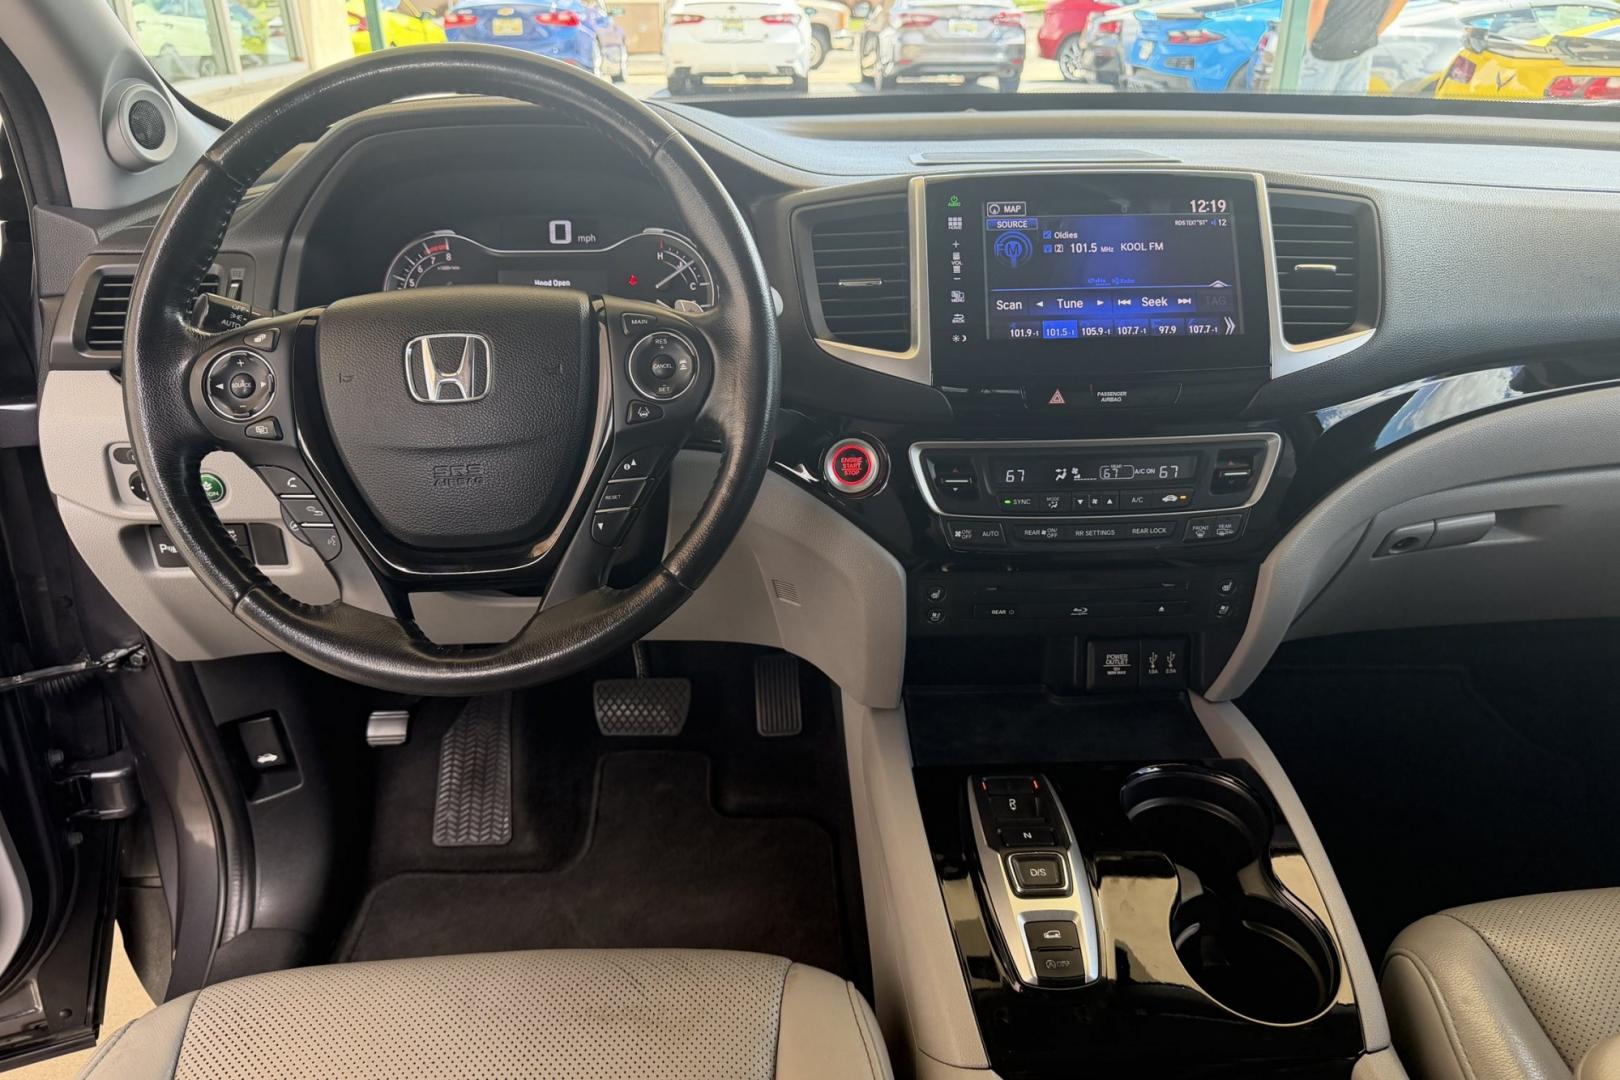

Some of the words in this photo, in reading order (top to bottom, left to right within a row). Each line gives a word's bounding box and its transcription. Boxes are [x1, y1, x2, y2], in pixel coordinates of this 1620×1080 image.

[1003, 204, 1022, 213] MAP
[1189, 199, 1227, 213] 12:19
[996, 220, 1029, 229] SOURCE
[1218, 218, 1227, 227] 12
[549, 220, 572, 244] 0
[1053, 231, 1079, 239] Oldies
[577, 235, 597, 243] mph
[1070, 242, 1098, 253] 101.5
[1120, 242, 1148, 251] KOOL
[1149, 241, 1164, 251] FM
[656, 252, 664, 261] H
[552, 279, 571, 287] Open
[689, 282, 697, 291] C
[996, 300, 1023, 311] Scan
[1056, 298, 1084, 309] Tune
[1141, 296, 1168, 307] Seek
[221, 318, 241, 328] AUTO
[1158, 325, 1177, 334] 97.9
[1005, 469, 1025, 483] 67
[1103, 468, 1119, 479] 67
[1159, 465, 1179, 479] 67
[1131, 496, 1144, 504] A/C
[1150, 526, 1167, 534] LOCK
[1022, 831, 1033, 839] N
[1029, 868, 1047, 877] D/S
